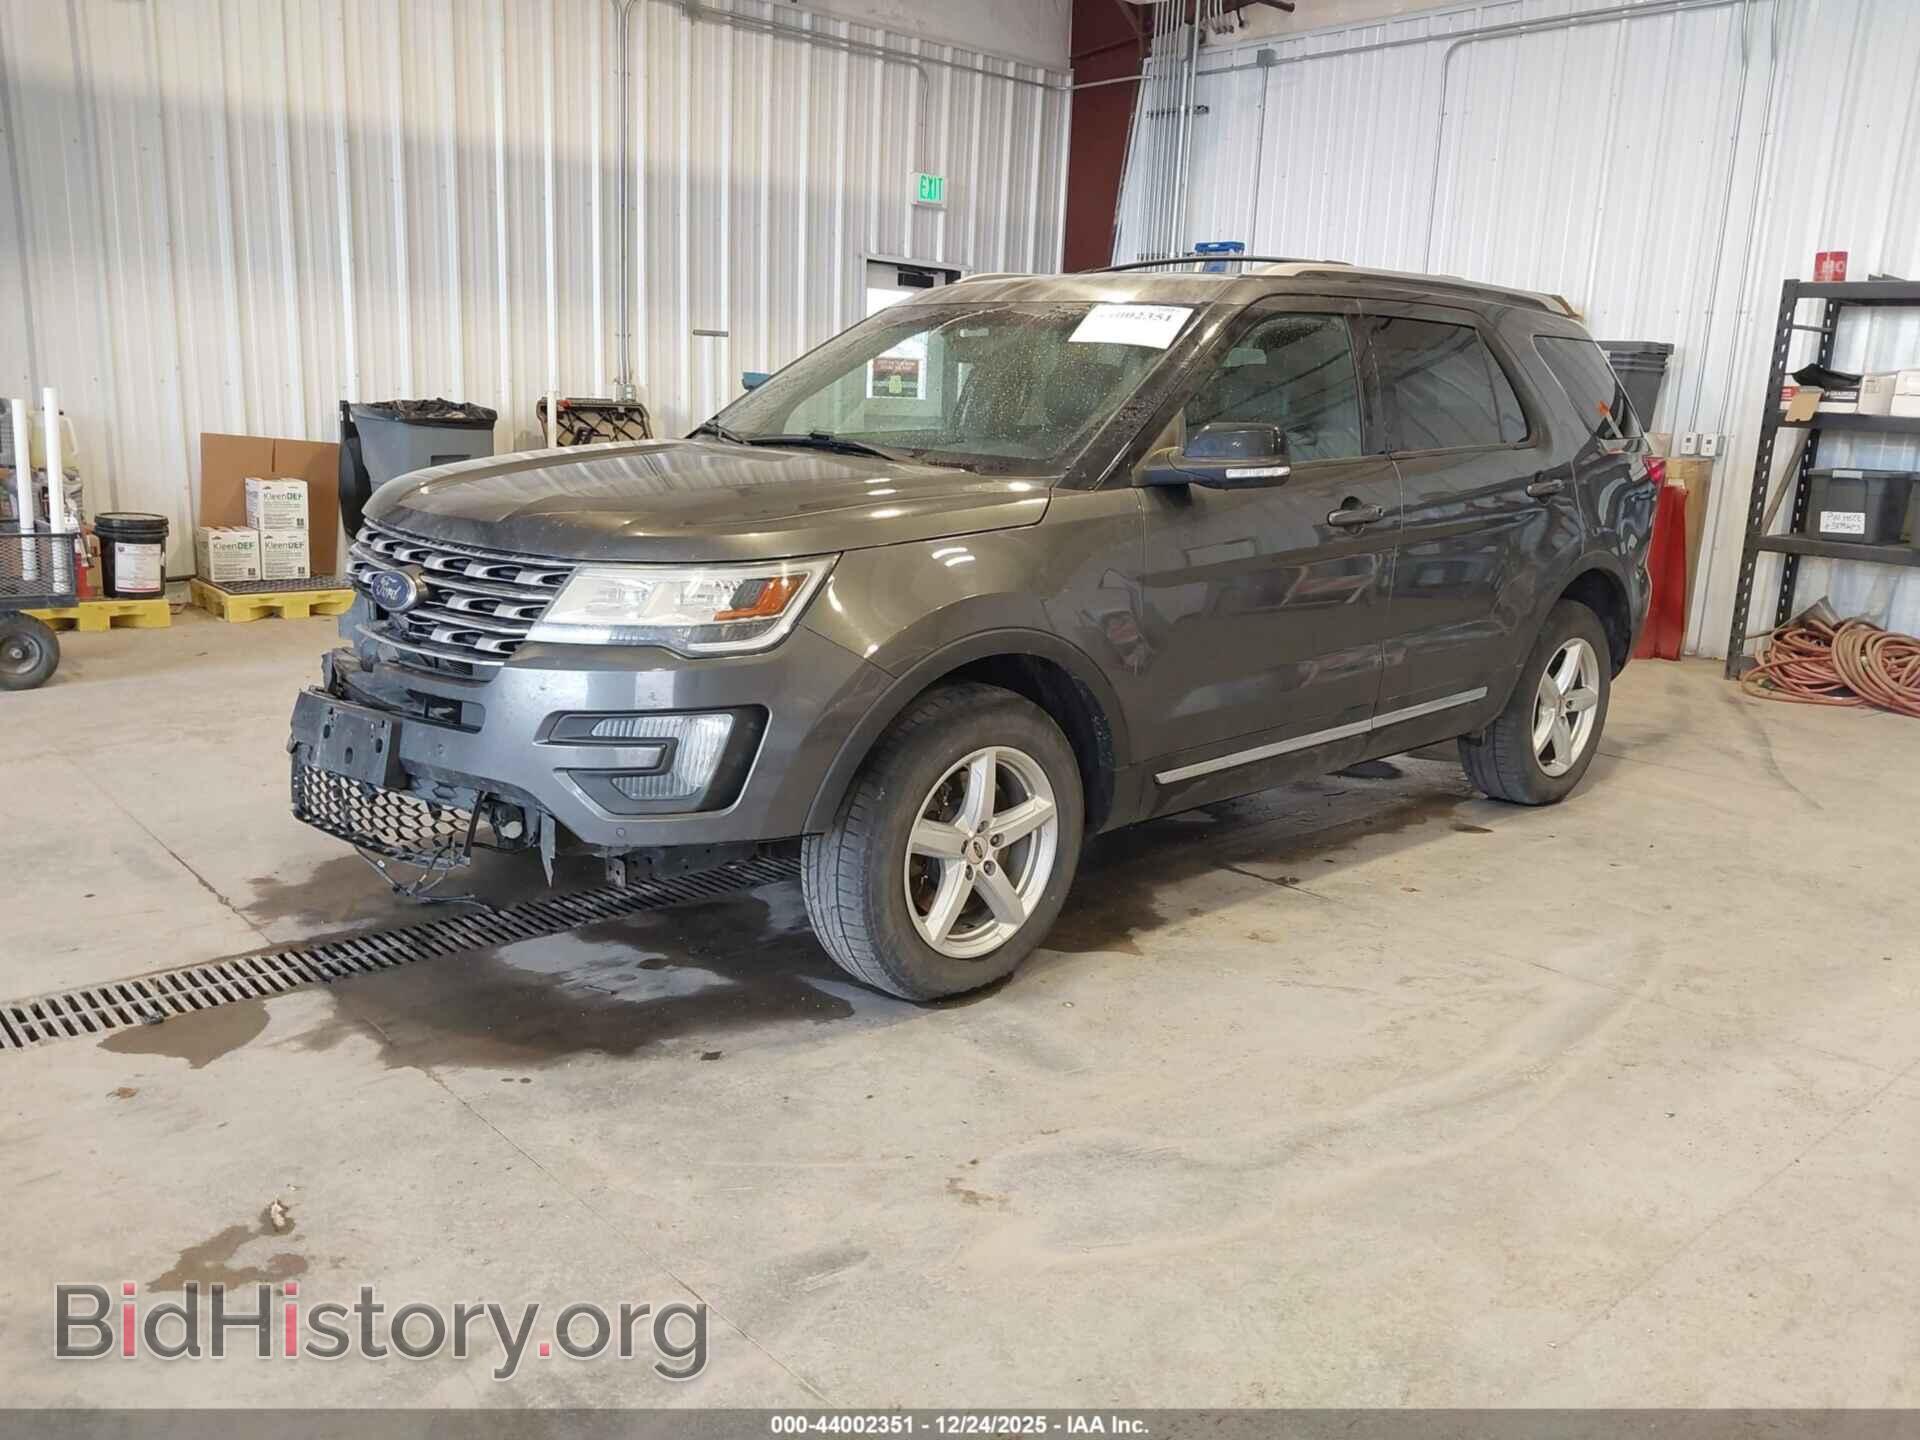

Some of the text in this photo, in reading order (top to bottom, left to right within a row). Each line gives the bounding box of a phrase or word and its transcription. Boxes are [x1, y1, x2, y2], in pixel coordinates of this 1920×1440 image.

[919, 175, 944, 200] EXIT
[263, 492, 304, 501] KleenDEF
[213, 542, 255, 551] KleenDEF
[375, 575, 402, 601] Ford
